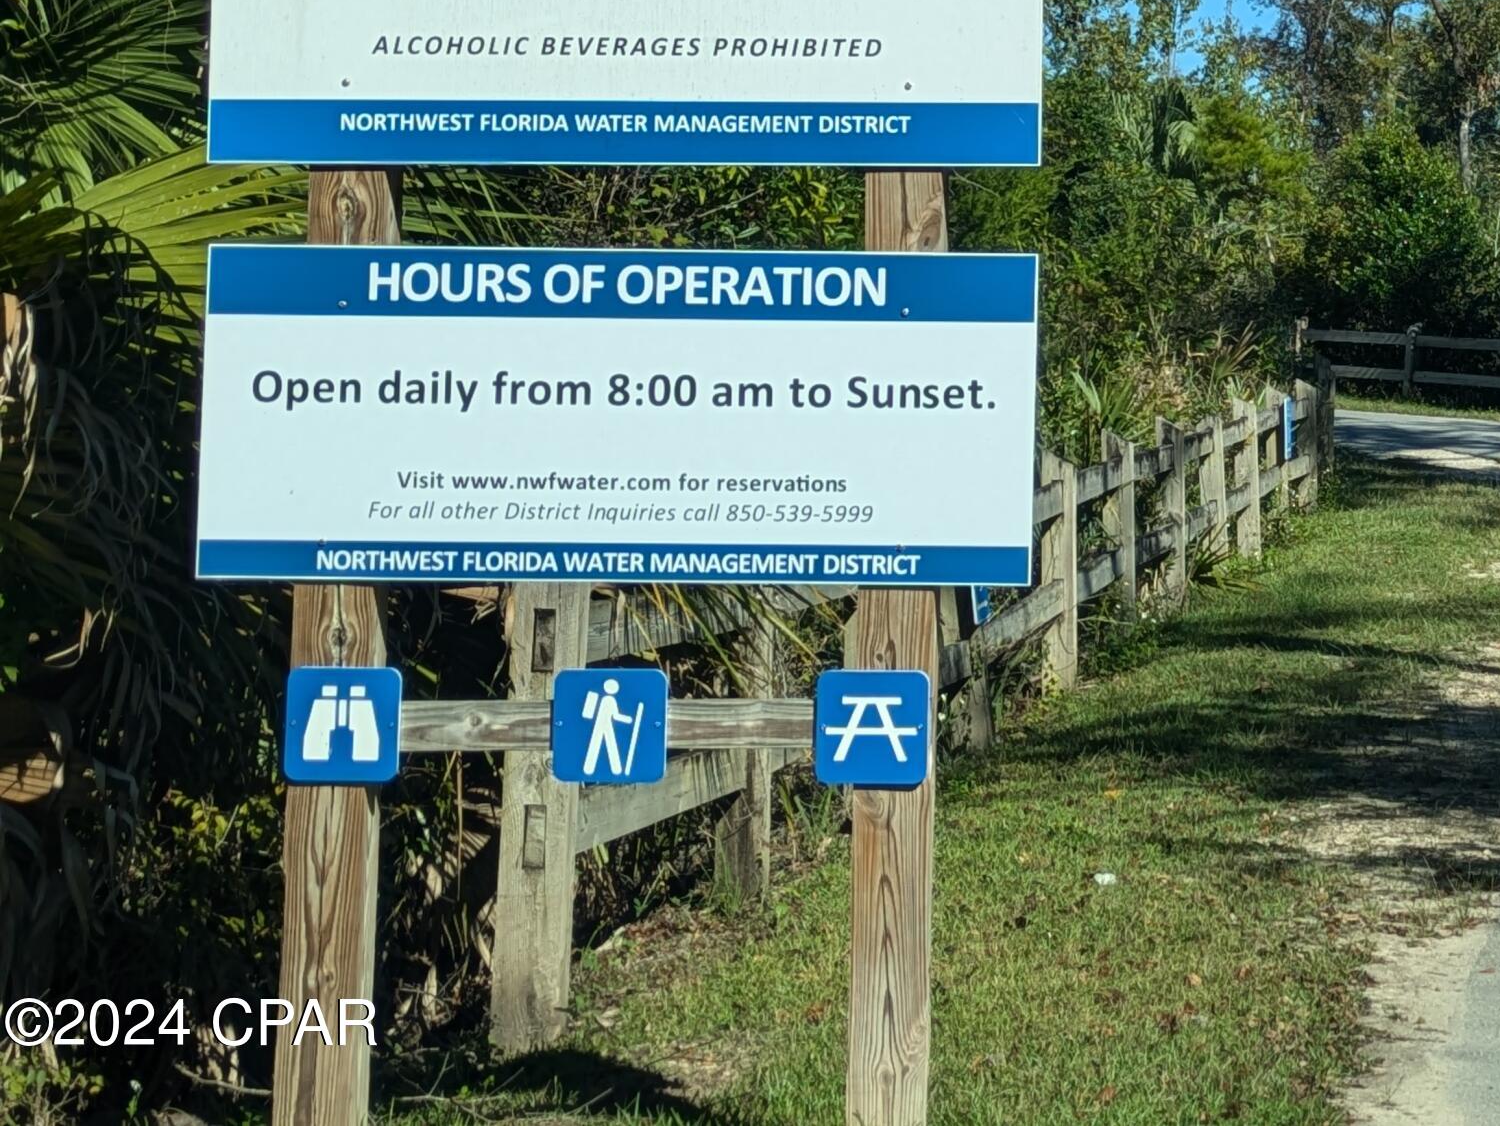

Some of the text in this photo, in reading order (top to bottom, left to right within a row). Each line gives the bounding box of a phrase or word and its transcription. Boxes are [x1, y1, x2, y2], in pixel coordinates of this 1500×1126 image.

[371, 35, 882, 57] ALCOHOLIC BEVERAGES PROHIBITED
[340, 113, 911, 134] NORTHWEST FLORIDA WATER MANAGEMENT DISTRICT
[368, 262, 887, 307] HOURS OF OPERATION
[252, 369, 996, 413] Open daily from 8:00 am to Sunset.
[397, 471, 847, 493] Visit www.nwfwater.com for reservations
[368, 500, 874, 525] For all other District Inquiries call 850-539-5999
[316, 549, 921, 575] NORTHWEST FLORIDA WATER MANAGEMENT DISTRICT
